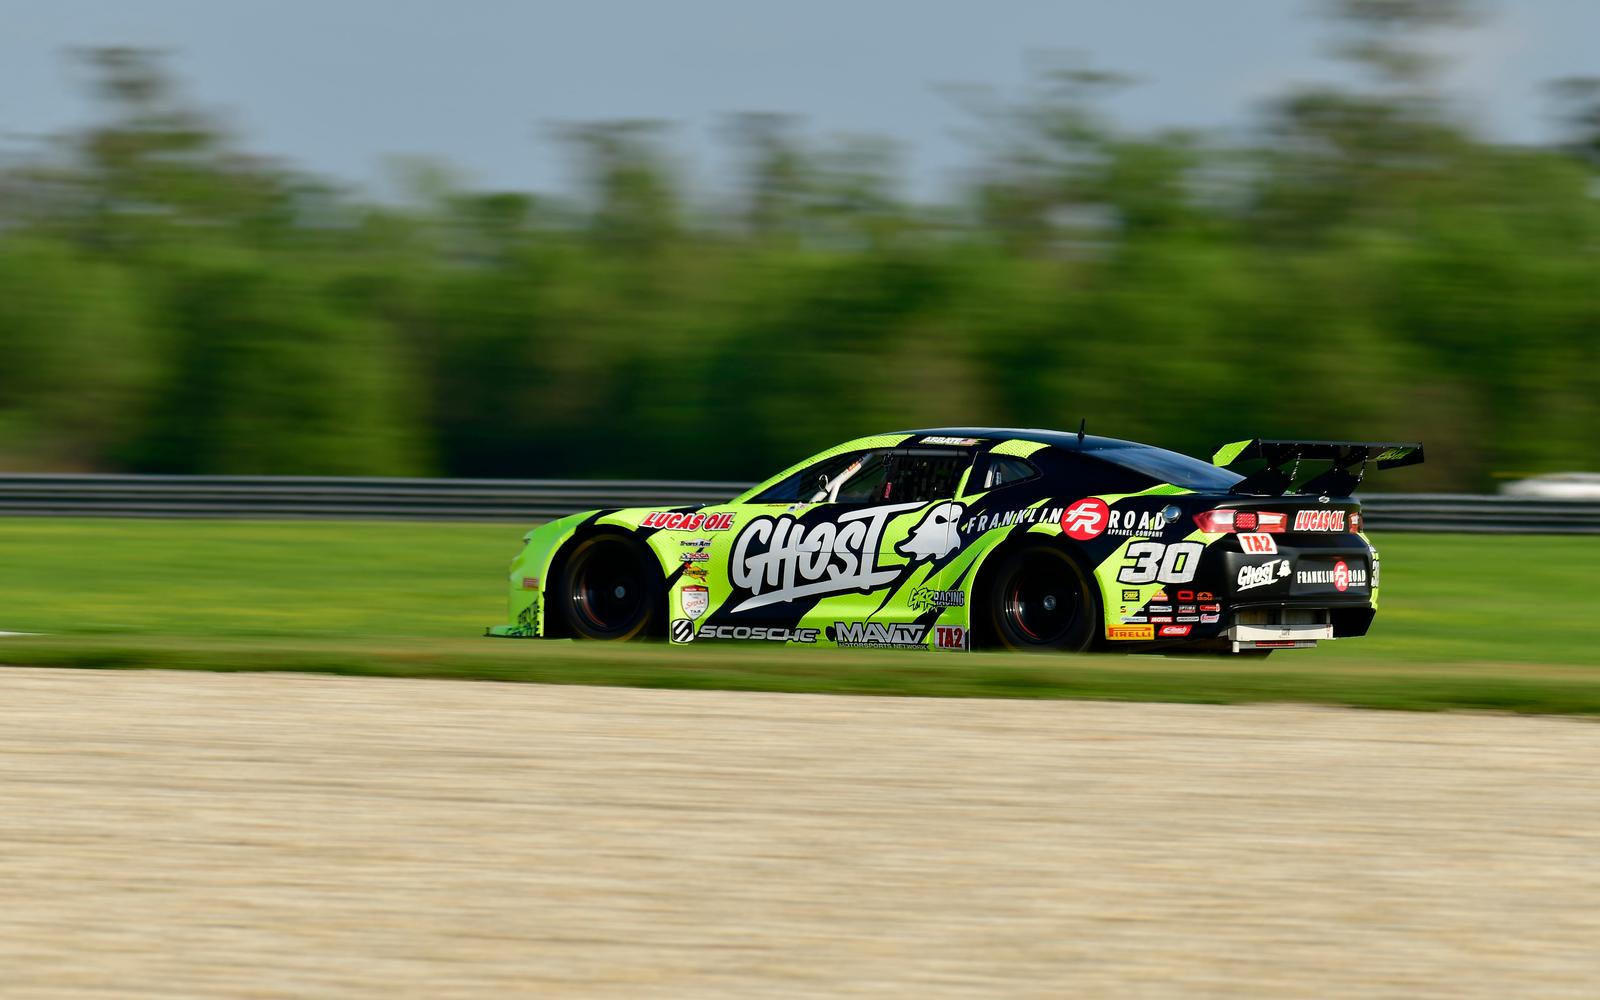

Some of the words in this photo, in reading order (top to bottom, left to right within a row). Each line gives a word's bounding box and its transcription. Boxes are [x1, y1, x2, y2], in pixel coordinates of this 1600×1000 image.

[641, 512, 704, 531] LUCAS
[703, 513, 736, 531] OIL
[966, 507, 1064, 535] FRANKLIN
[1107, 510, 1166, 531] ROAD
[1294, 510, 1331, 531] LUCAS
[1329, 510, 1345, 531] OIL
[1107, 529, 1133, 537] APPAREL
[1135, 530, 1164, 538] COMPANY
[1242, 535, 1273, 552] TA2
[730, 501, 930, 613] GHOST
[1119, 542, 1203, 584] 30
[1237, 559, 1282, 592] GHOST
[1297, 570, 1334, 584] FRANKLIN
[1348, 570, 1366, 583] ROAD
[934, 590, 965, 607] RACING
[698, 625, 820, 643] SCOSCHE
[936, 627, 963, 648] TA2
[1108, 627, 1151, 637] PIRELLI
